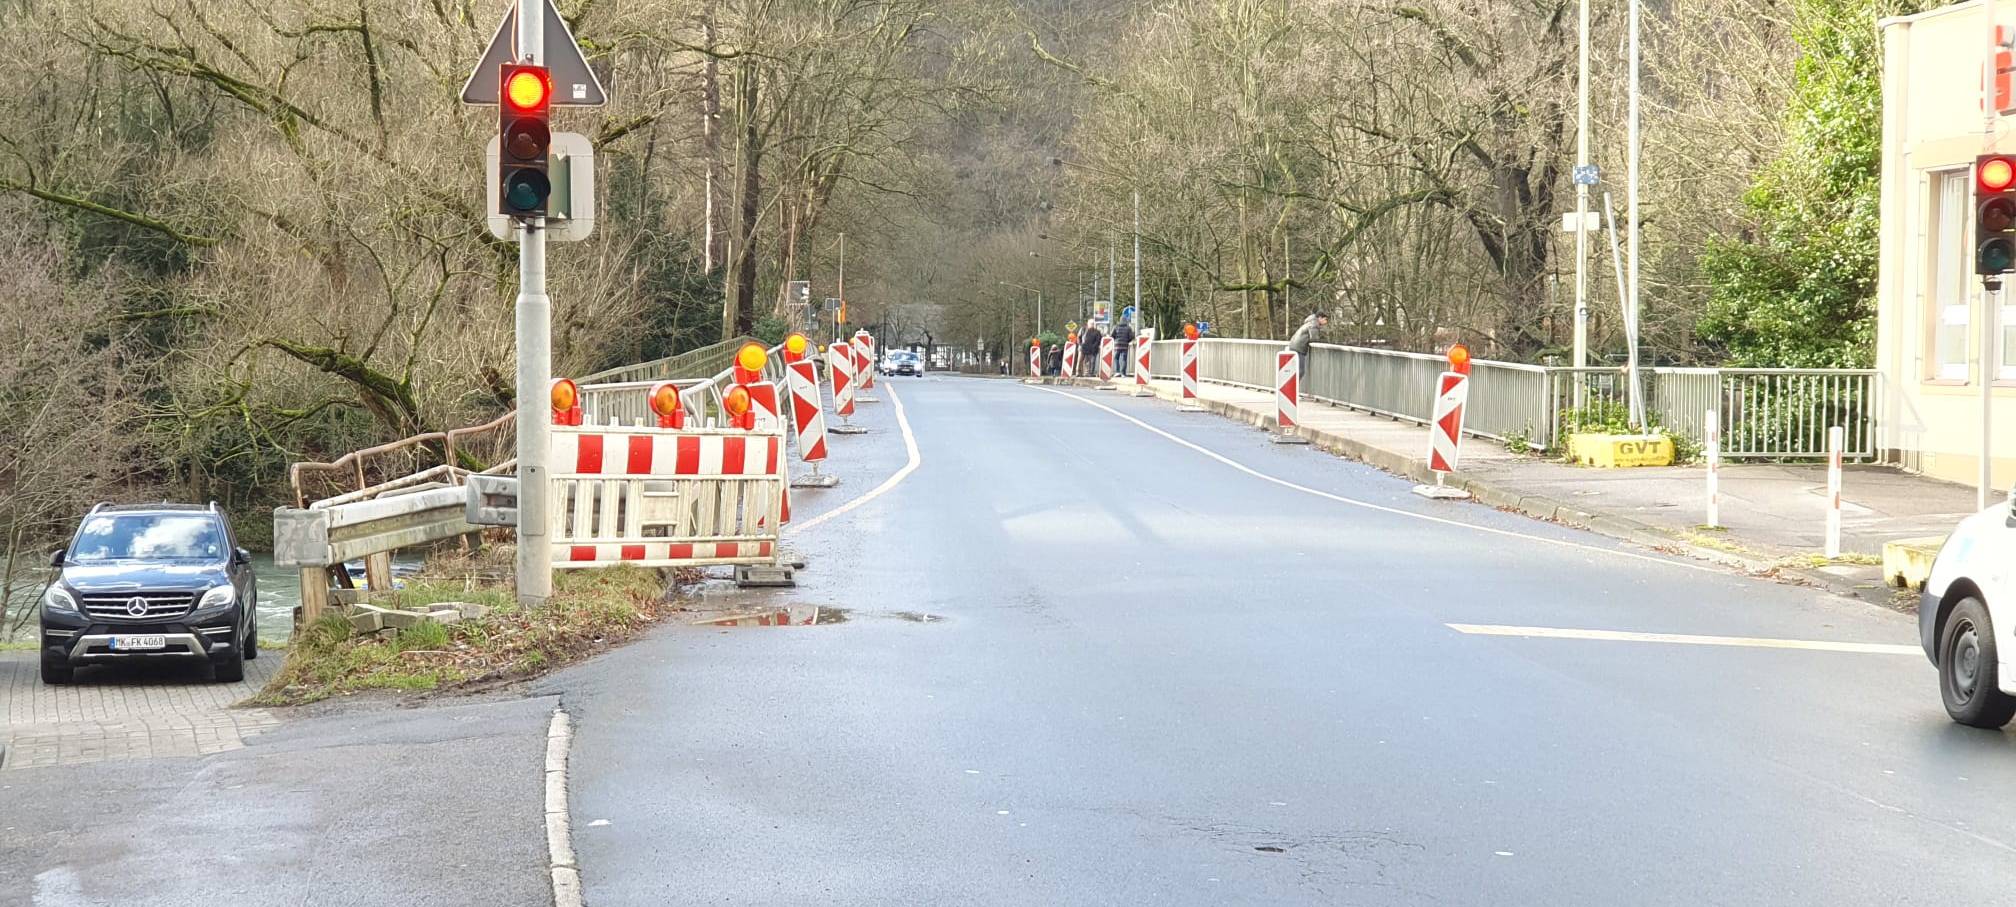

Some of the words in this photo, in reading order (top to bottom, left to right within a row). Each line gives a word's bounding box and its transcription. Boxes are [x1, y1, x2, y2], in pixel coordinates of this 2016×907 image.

[1619, 441, 1661, 455] GVT
[115, 637, 126, 646] MK
[131, 637, 142, 646] FK
[143, 637, 164, 646] 4068
